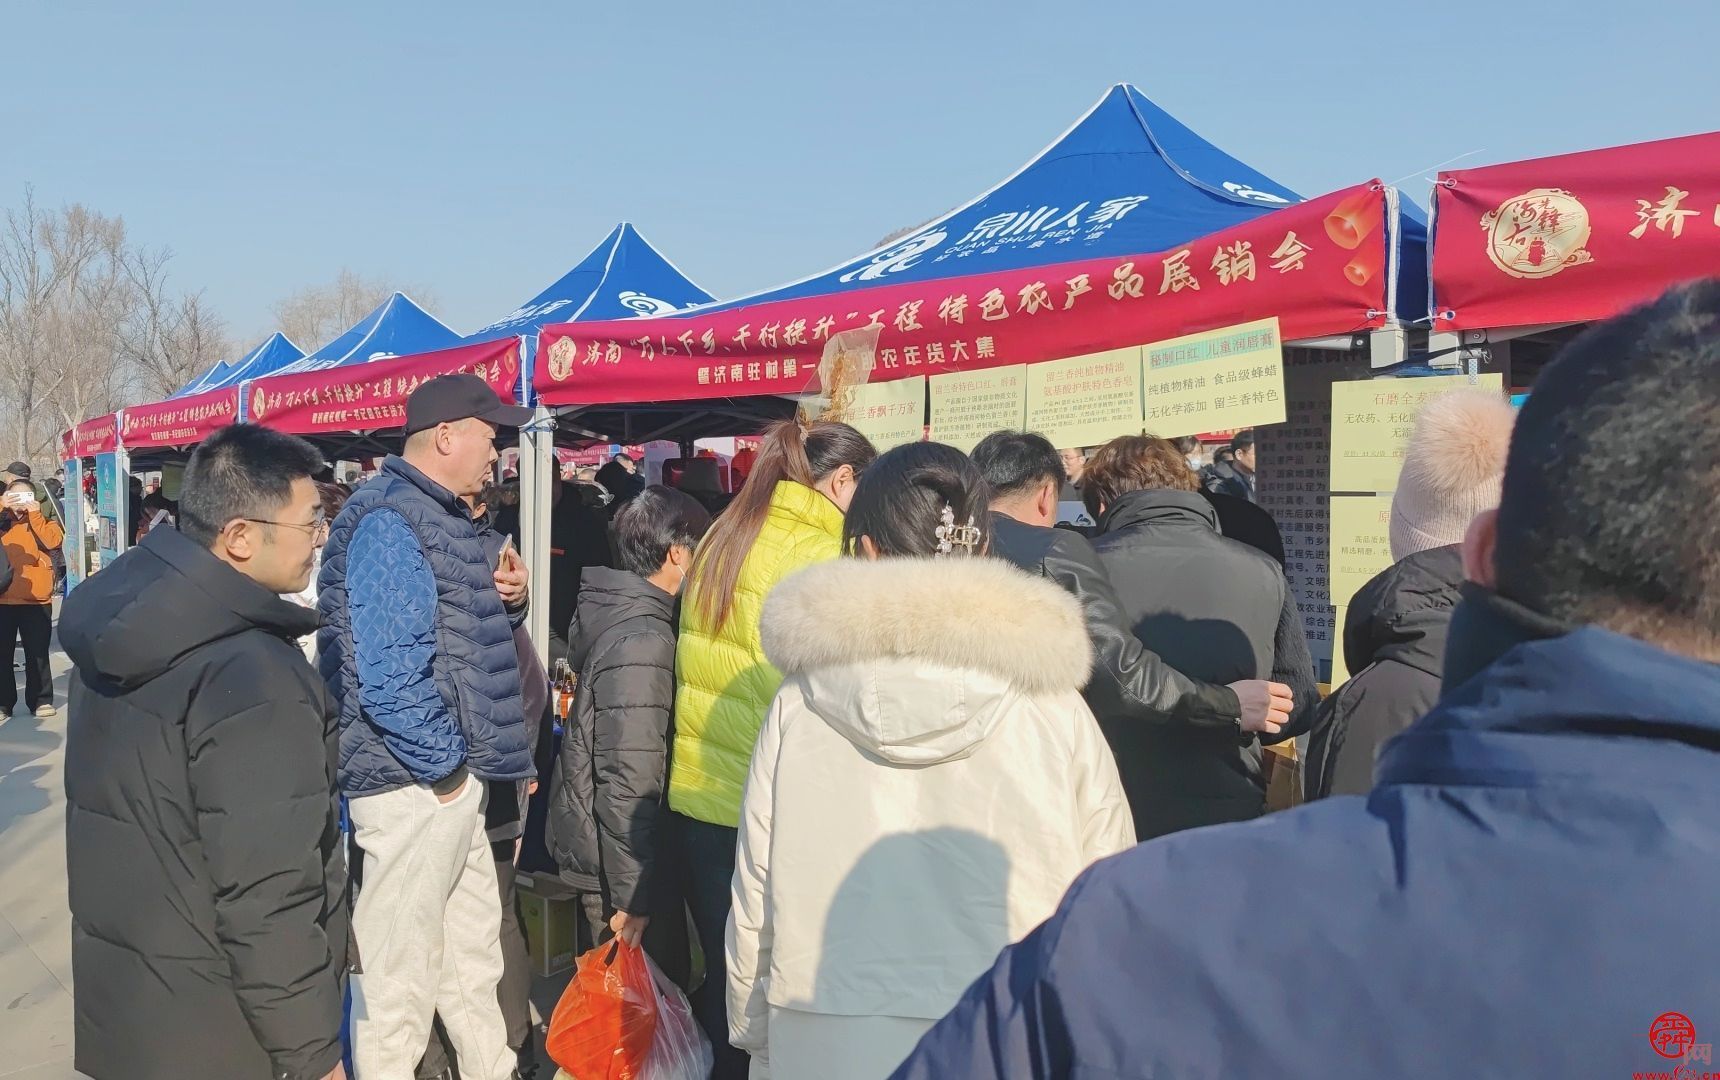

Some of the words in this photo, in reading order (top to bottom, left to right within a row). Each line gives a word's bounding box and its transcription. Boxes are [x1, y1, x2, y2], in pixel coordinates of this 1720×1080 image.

[1628, 185, 1720, 241] 济
[944, 240, 992, 254] QUAN
[994, 233, 1038, 247] SHUI
[1043, 227, 1082, 240] REN
[1086, 222, 1113, 234] JIA
[697, 336, 996, 386] 暨济南驻村第一助农年货大集
[1151, 346, 1198, 367] 秘制口红
[1207, 332, 1273, 357] 儿童润唇膏
[1046, 361, 1125, 383] 留兰香纯植物精油
[1148, 376, 1206, 396] 纯植物精油
[1214, 364, 1278, 386] 食品级蜂蜡
[1149, 400, 1207, 420] 无化学添加
[1214, 389, 1279, 410] 留兰香特色
[1285, 549, 1330, 560] 工程先进
